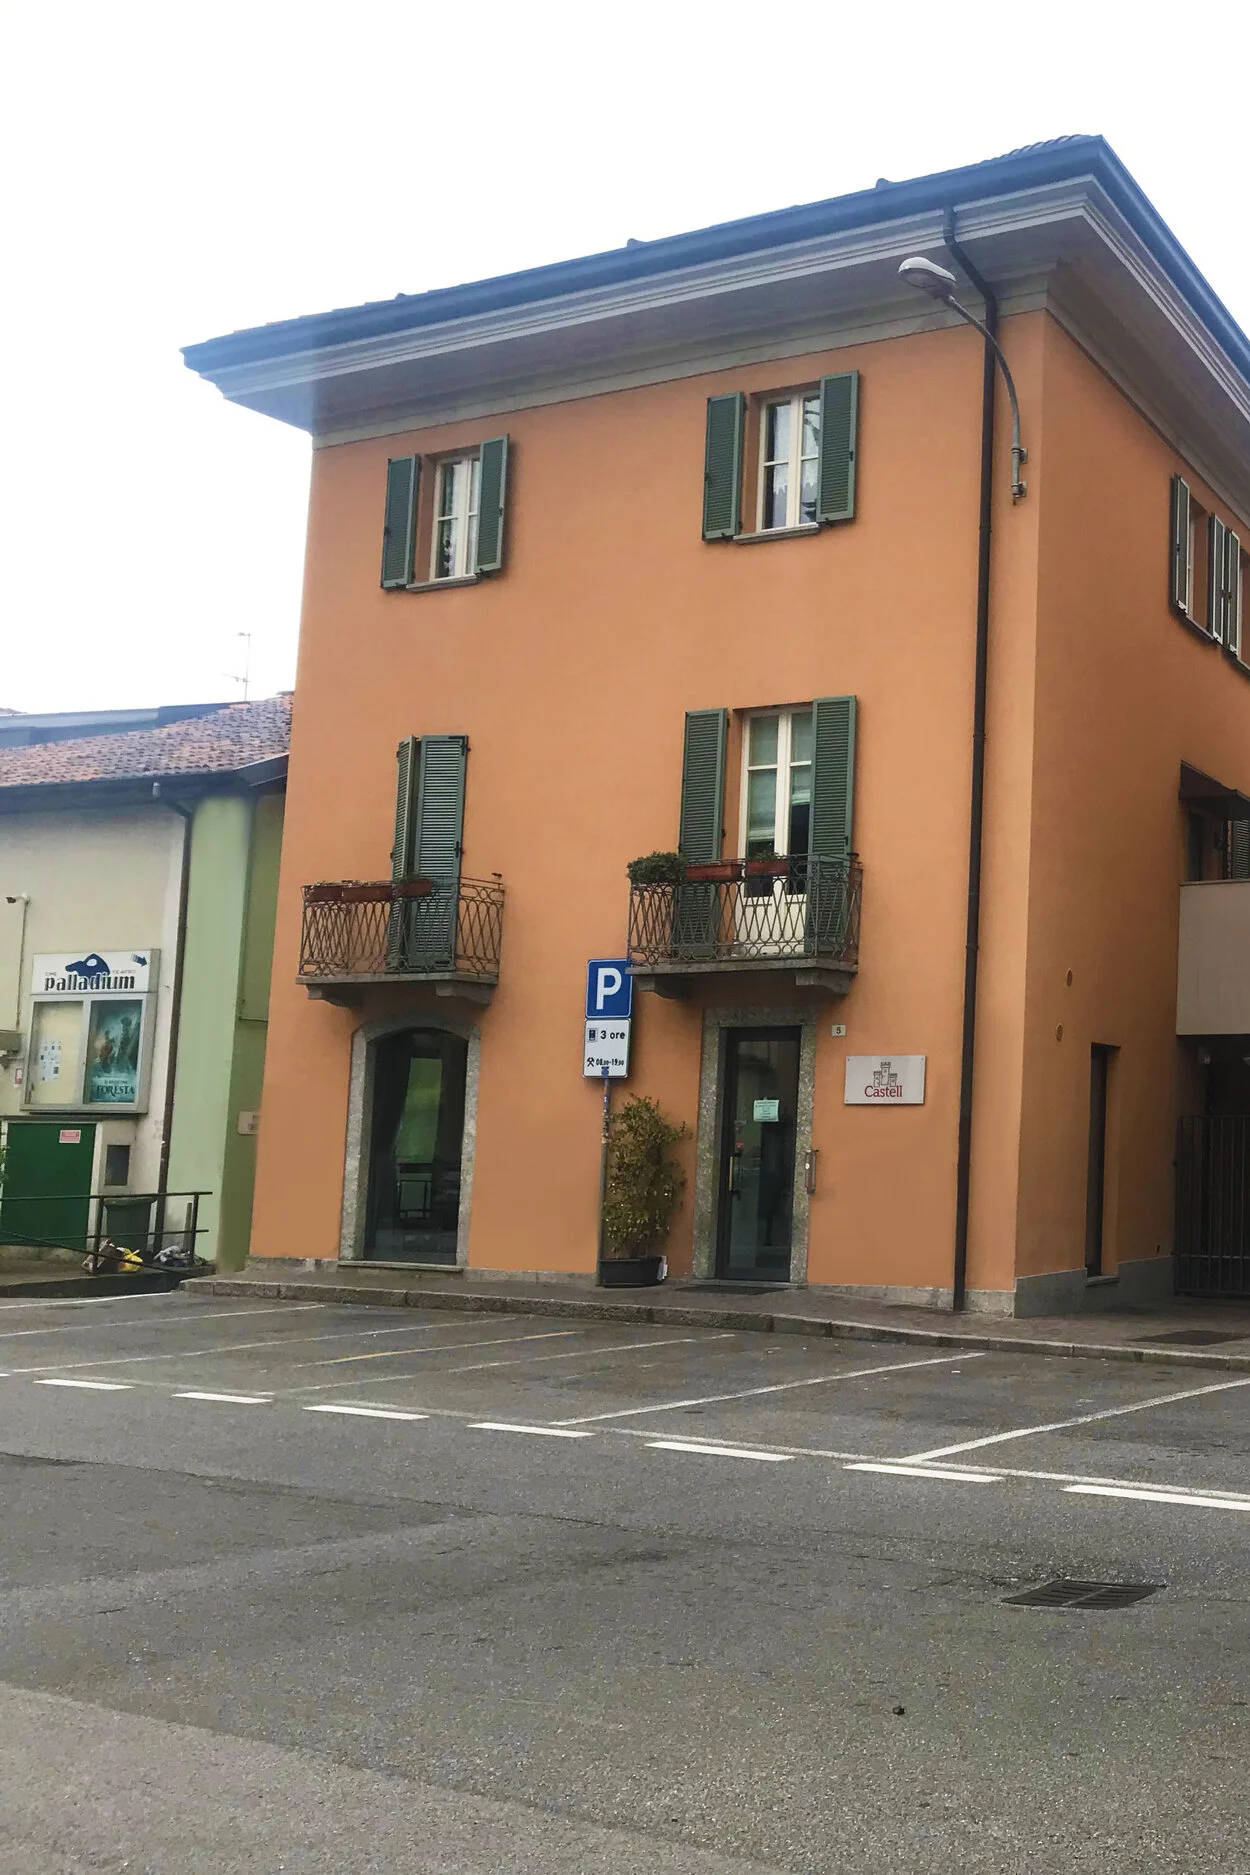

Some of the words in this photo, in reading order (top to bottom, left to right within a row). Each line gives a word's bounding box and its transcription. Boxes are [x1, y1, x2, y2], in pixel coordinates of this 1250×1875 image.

[44, 973, 135, 991] palladium
[596, 967, 622, 1010] P
[600, 1030, 607, 1040] 3
[609, 1032, 626, 1040] ore
[836, 1026, 842, 1035] 5
[96, 1085, 135, 1097] FORESTA
[864, 1085, 903, 1098] Castell
